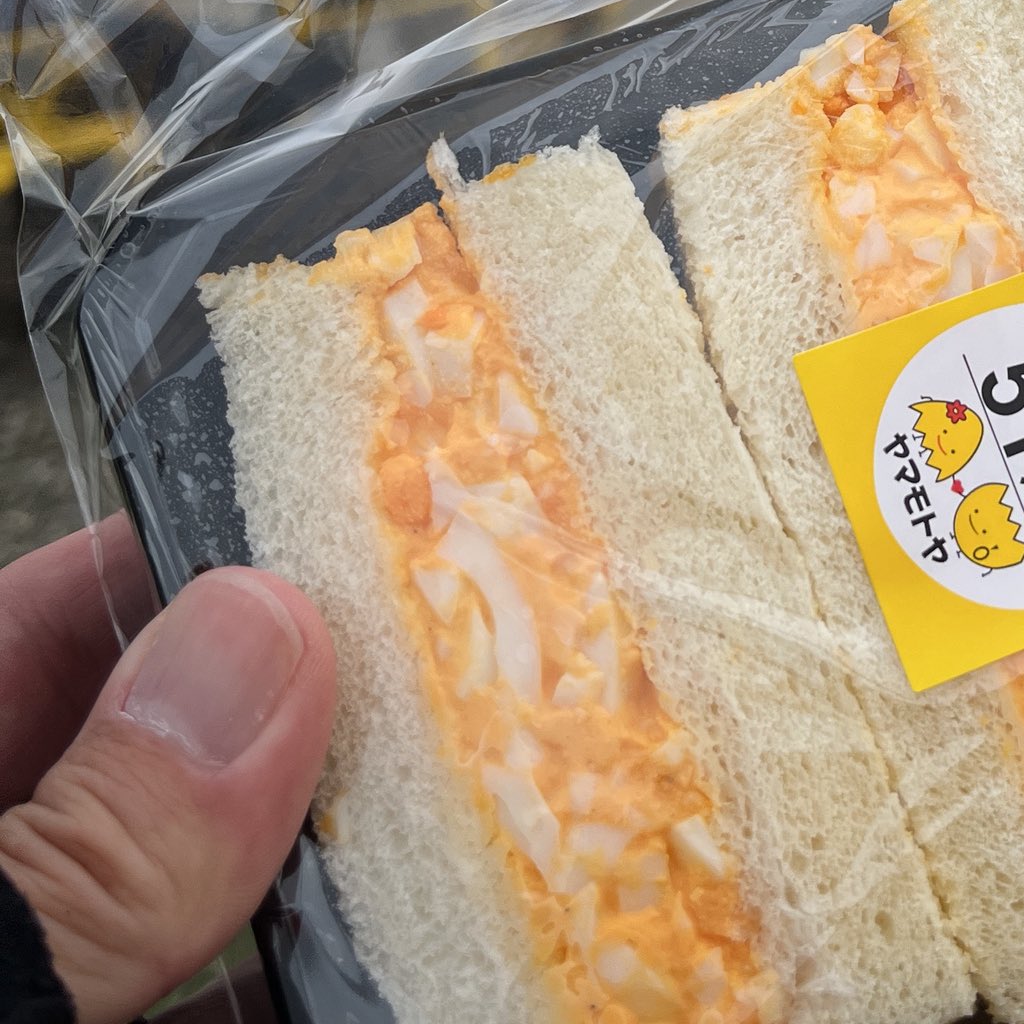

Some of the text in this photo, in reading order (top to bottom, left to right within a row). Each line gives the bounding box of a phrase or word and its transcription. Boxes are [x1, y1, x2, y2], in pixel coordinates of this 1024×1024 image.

[883, 432, 948, 563] ヤマモトヤ
